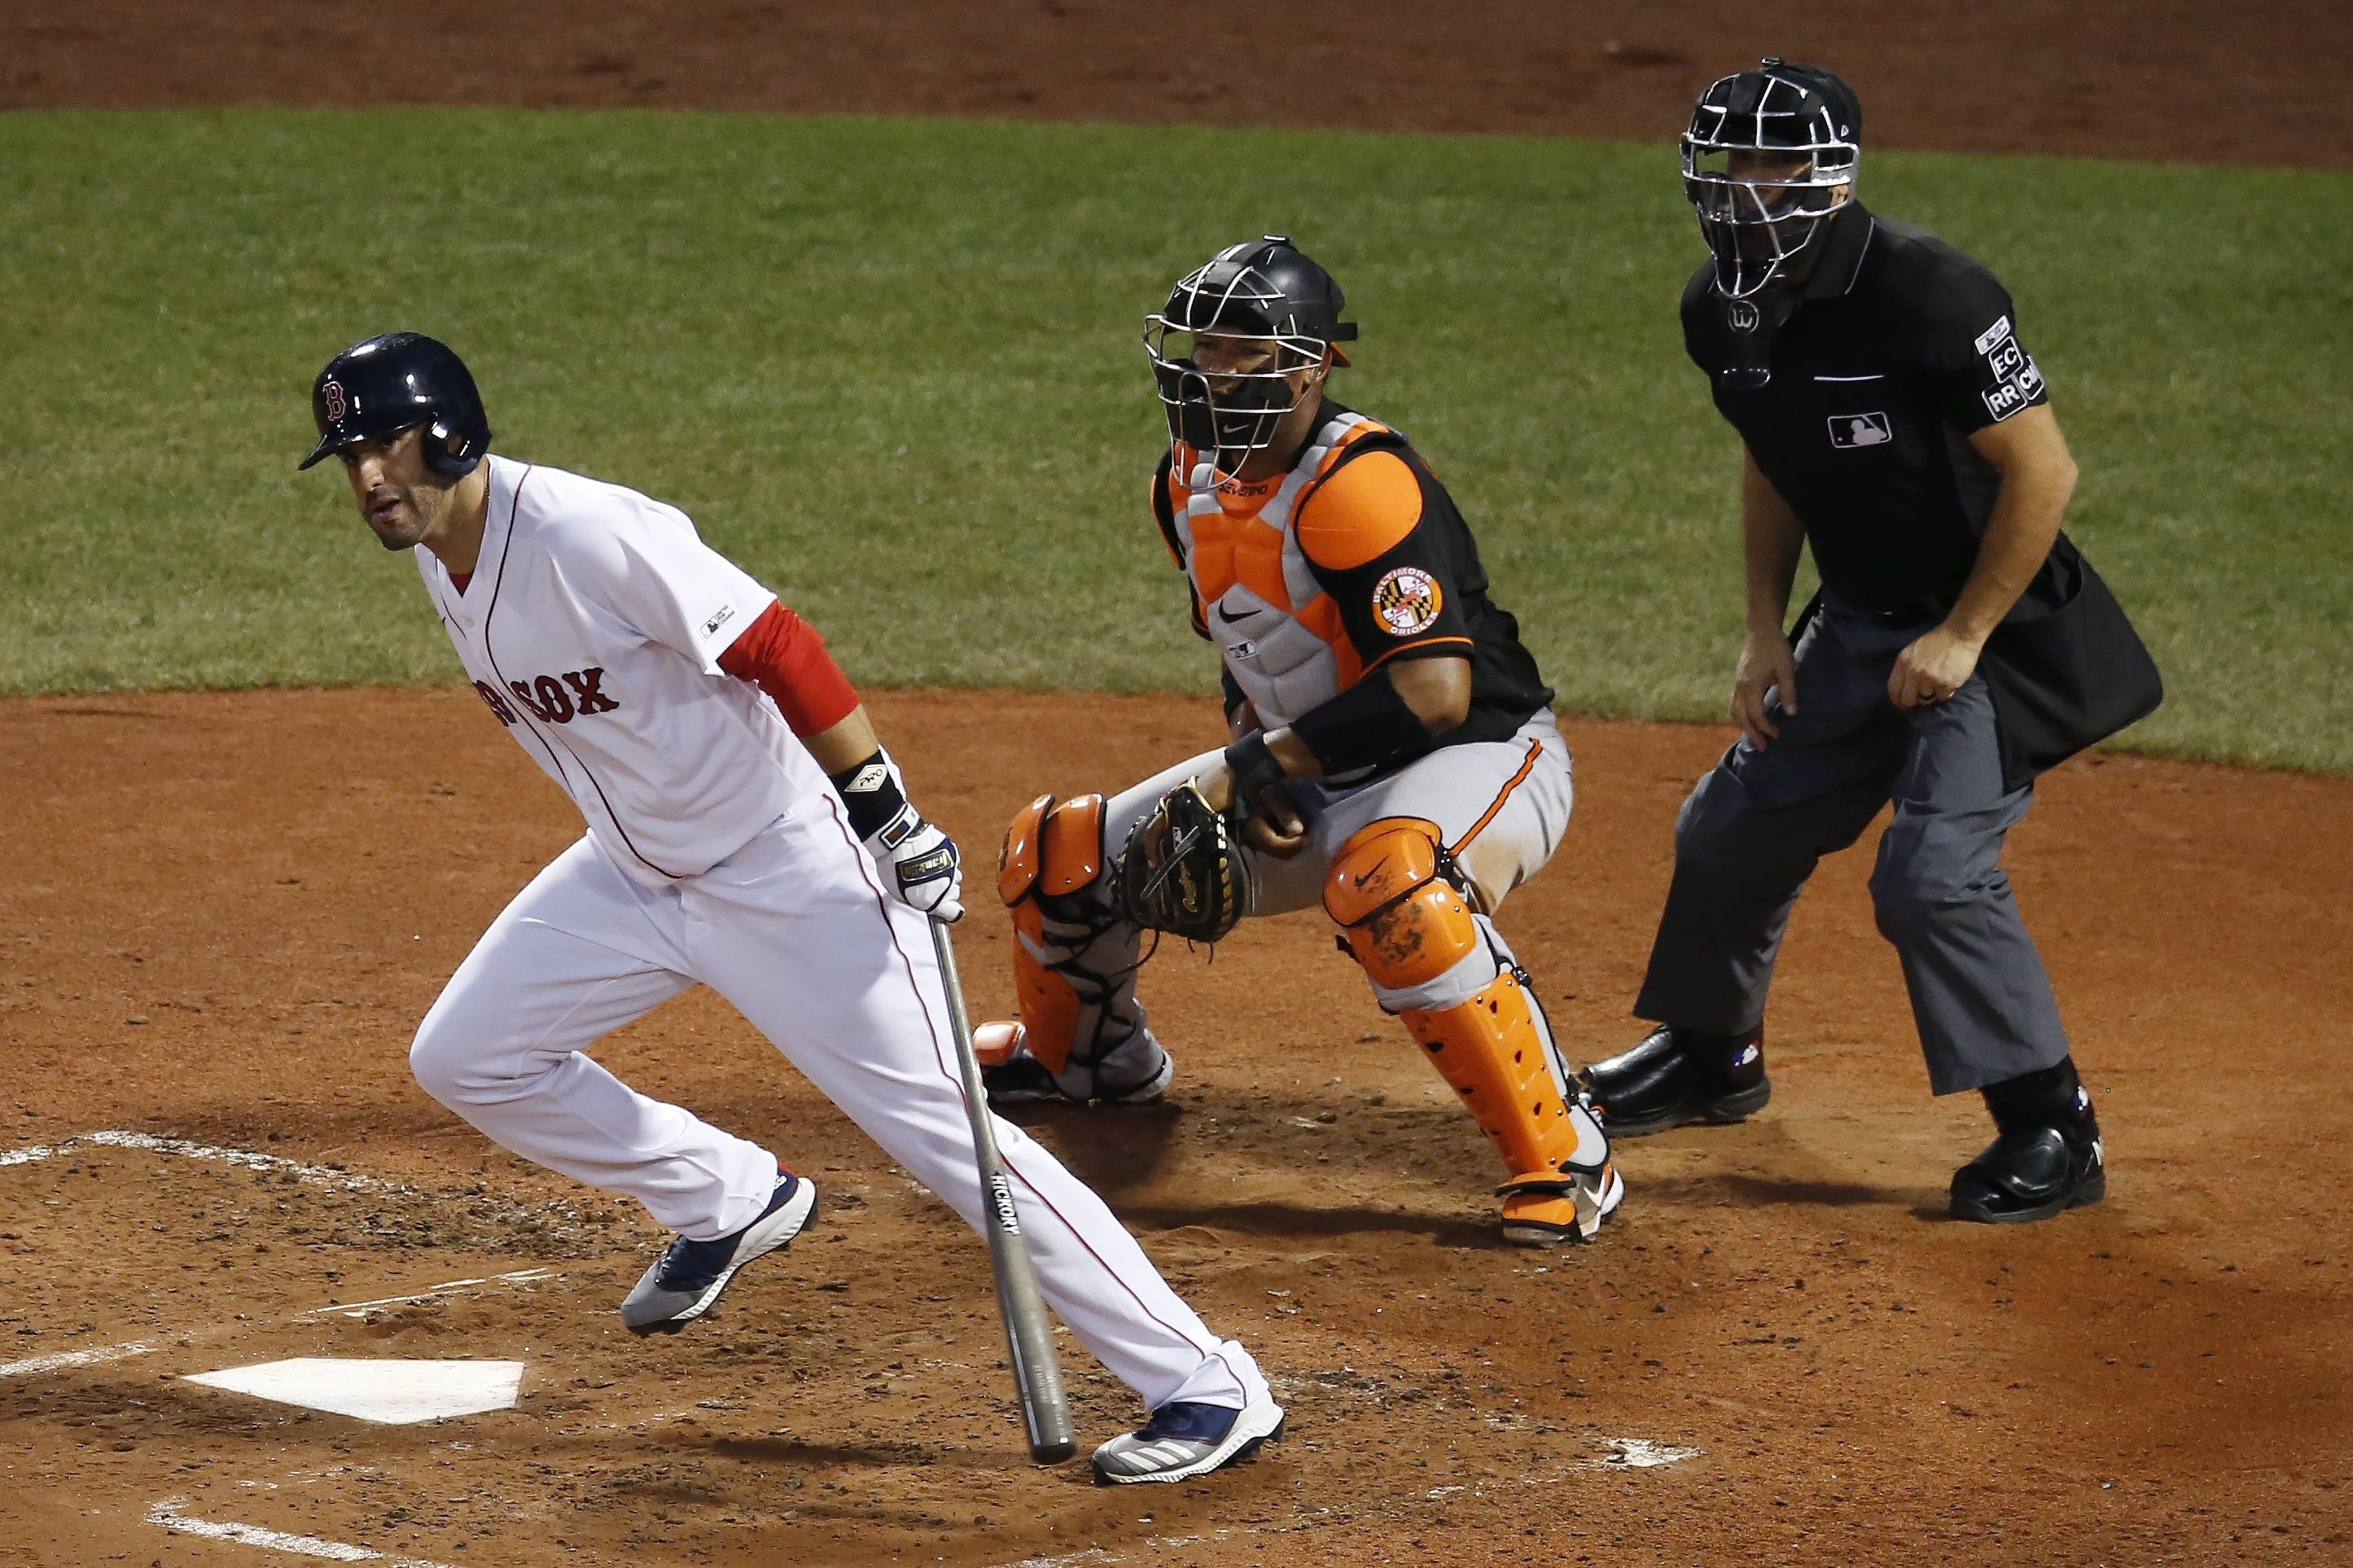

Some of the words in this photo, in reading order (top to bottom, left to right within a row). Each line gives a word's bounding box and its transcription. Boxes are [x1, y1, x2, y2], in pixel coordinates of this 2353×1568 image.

[1993, 347, 2018, 375] EC
[322, 380, 346, 422] B
[1988, 384, 2020, 413] RR
[1373, 567, 1433, 603] BALTIMORE
[510, 667, 620, 724] SOX
[989, 1175, 1022, 1237] HICKORY
